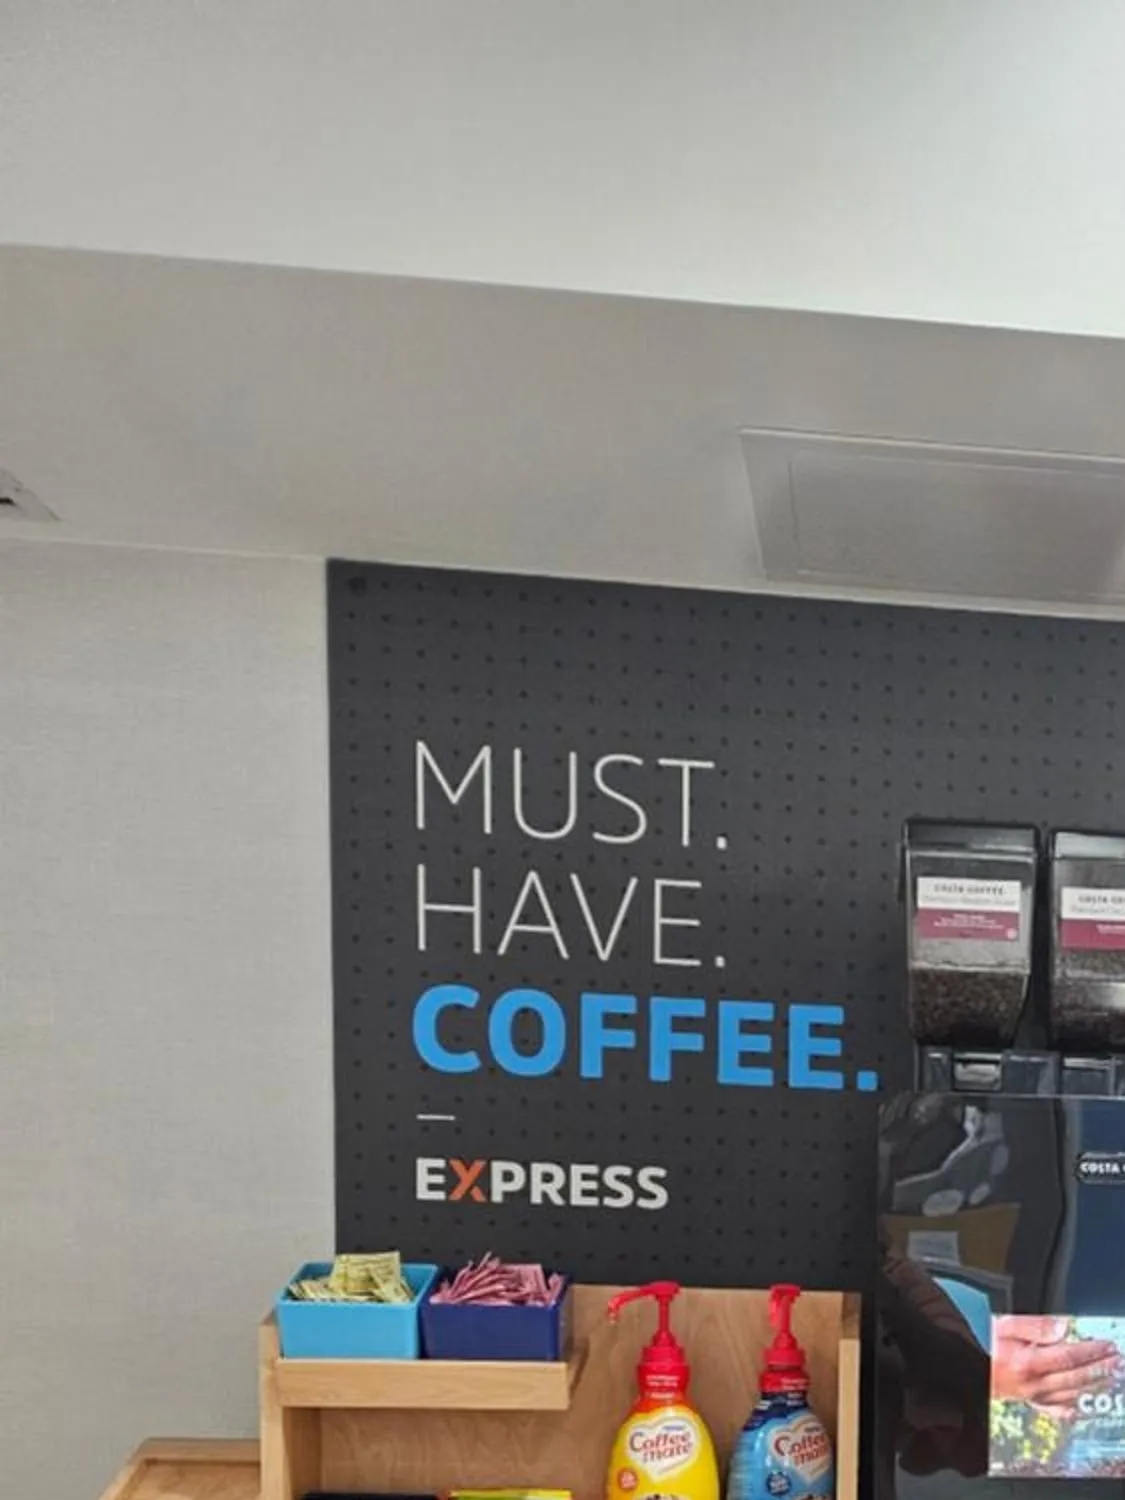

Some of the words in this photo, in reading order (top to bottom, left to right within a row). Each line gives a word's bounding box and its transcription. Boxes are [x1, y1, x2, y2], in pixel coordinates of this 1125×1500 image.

[416, 740, 728, 849] MUST.
[416, 863, 727, 968] HAVE.
[411, 983, 878, 1091] COFFEE.
[416, 1157, 669, 1210] EXPRESS
[1079, 1161, 1120, 1174] COSTA
[629, 1430, 692, 1453] Coffee
